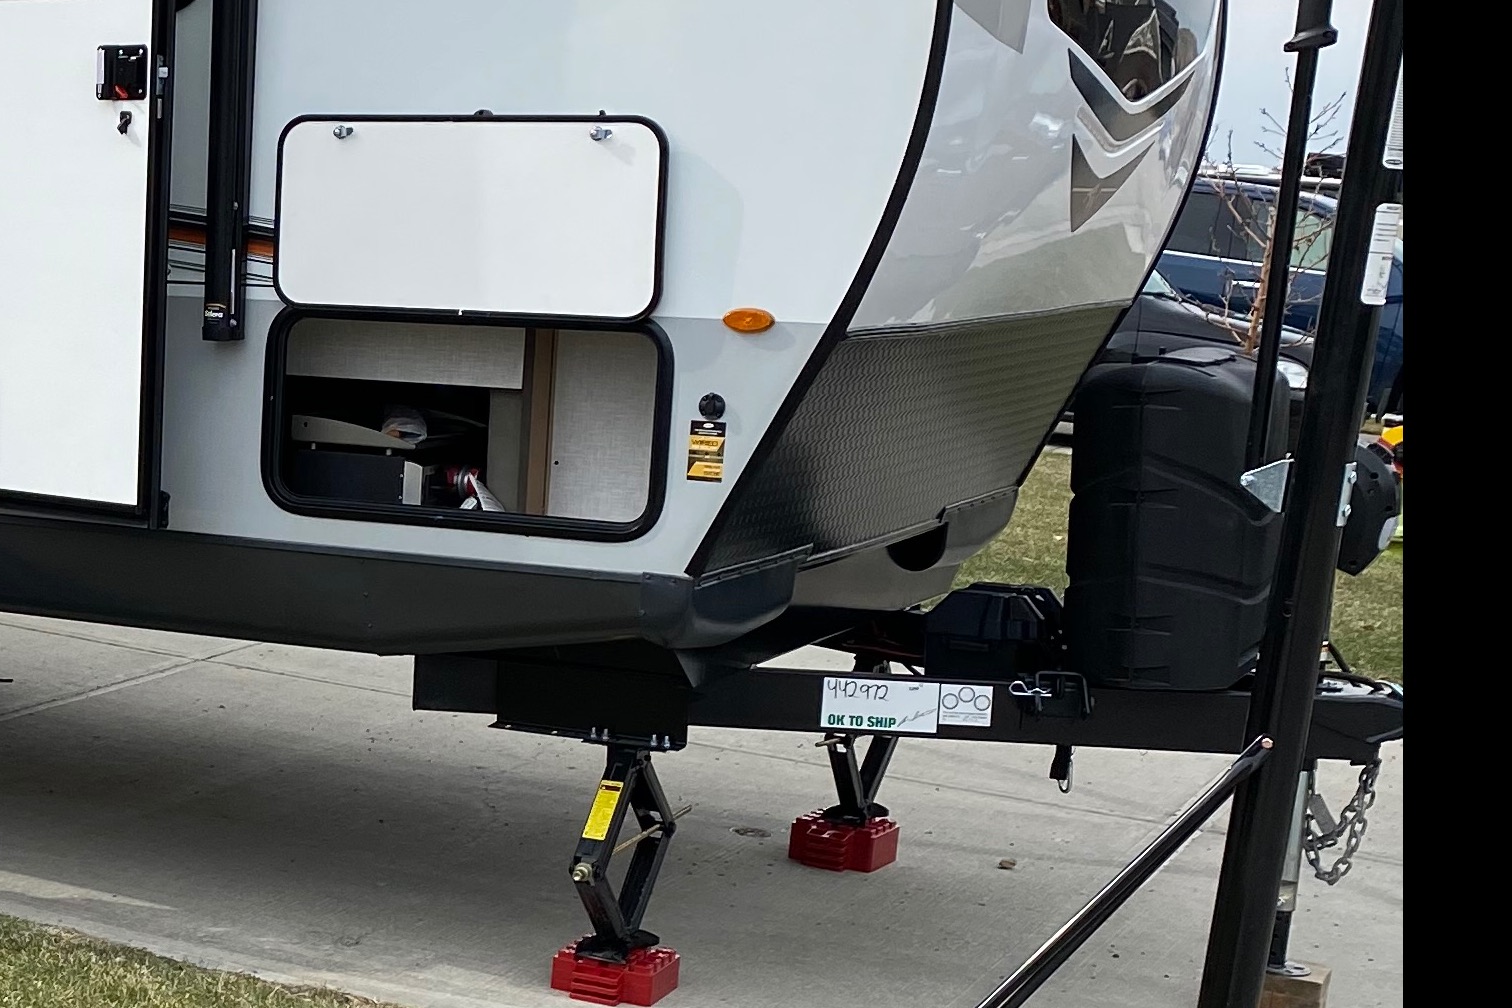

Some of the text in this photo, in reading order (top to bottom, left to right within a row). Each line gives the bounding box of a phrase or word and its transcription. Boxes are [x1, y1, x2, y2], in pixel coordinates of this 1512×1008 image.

[827, 714, 897, 729] OK TO SHIP
